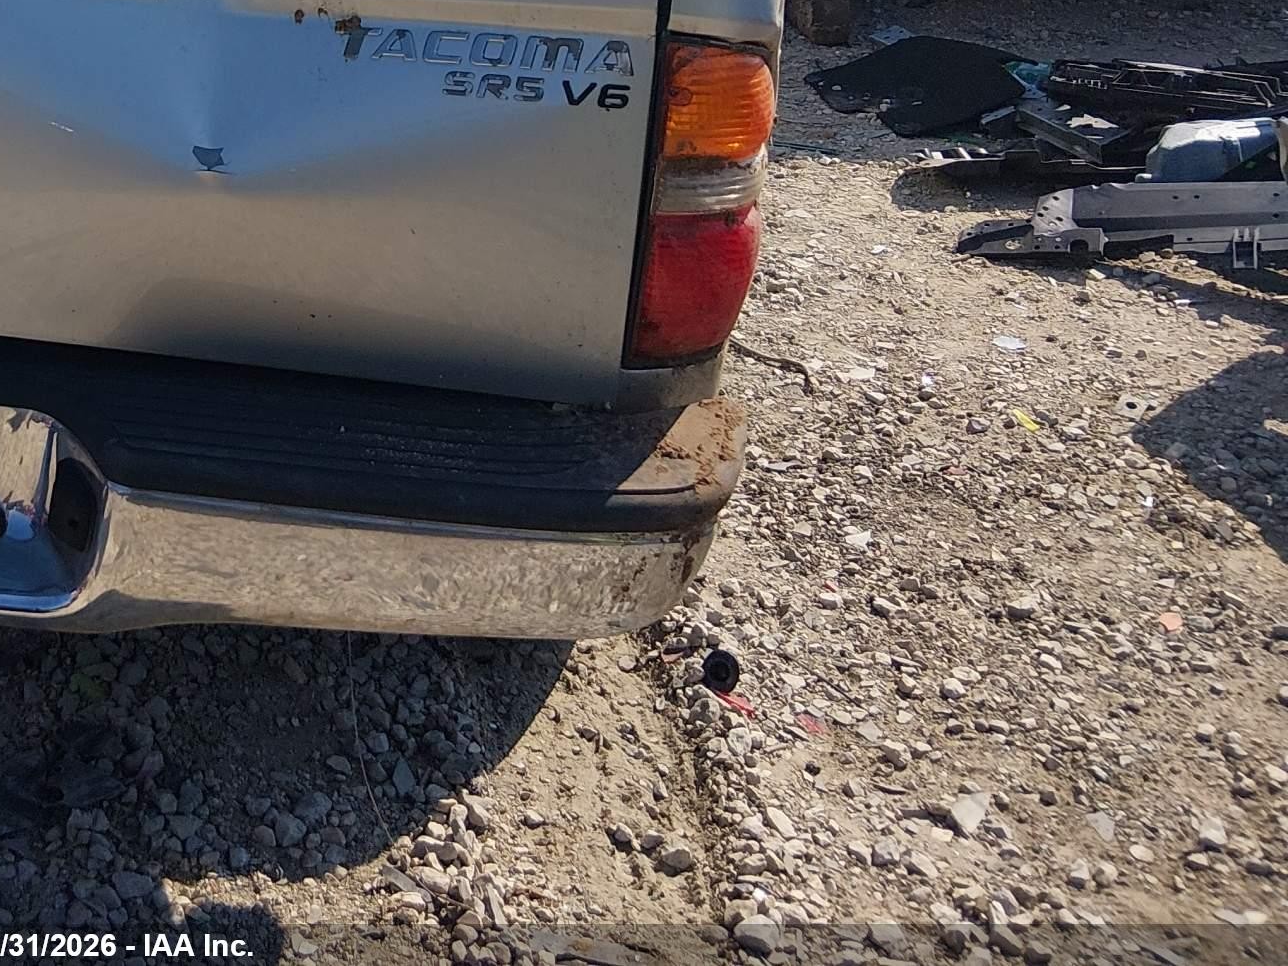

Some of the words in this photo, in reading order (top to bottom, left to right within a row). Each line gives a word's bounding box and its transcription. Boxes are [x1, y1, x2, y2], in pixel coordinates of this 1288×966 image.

[336, 26, 635, 77] TACOMA
[442, 70, 545, 102] SR5
[562, 80, 631, 110] V6
